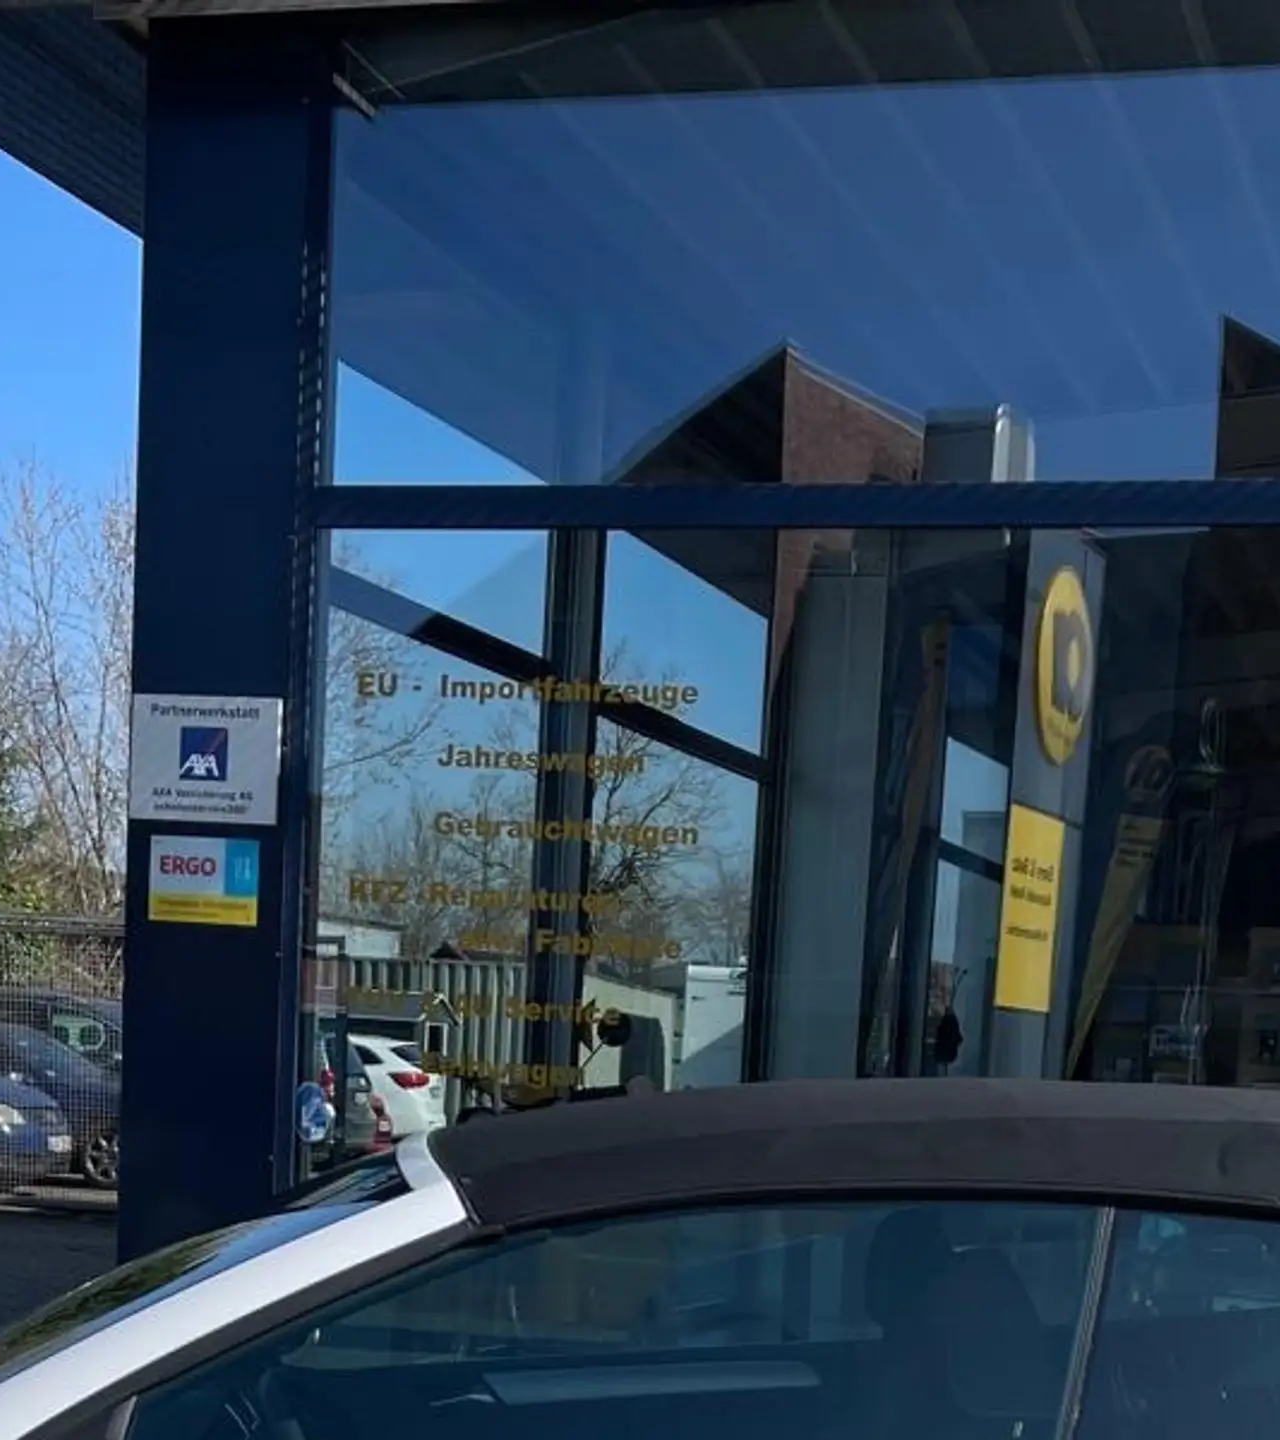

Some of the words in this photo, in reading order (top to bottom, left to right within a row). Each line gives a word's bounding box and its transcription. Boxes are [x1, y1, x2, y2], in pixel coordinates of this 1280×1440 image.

[356, 670, 398, 698] EU
[440, 674, 700, 708] Importfahrzeuge
[150, 702, 260, 720] Partnerwerkstatt
[179, 752, 220, 778] AXA
[436, 743, 648, 780] Jahreswagen
[432, 811, 700, 851] Gebrauchtwagen
[159, 854, 217, 877] ERGO
